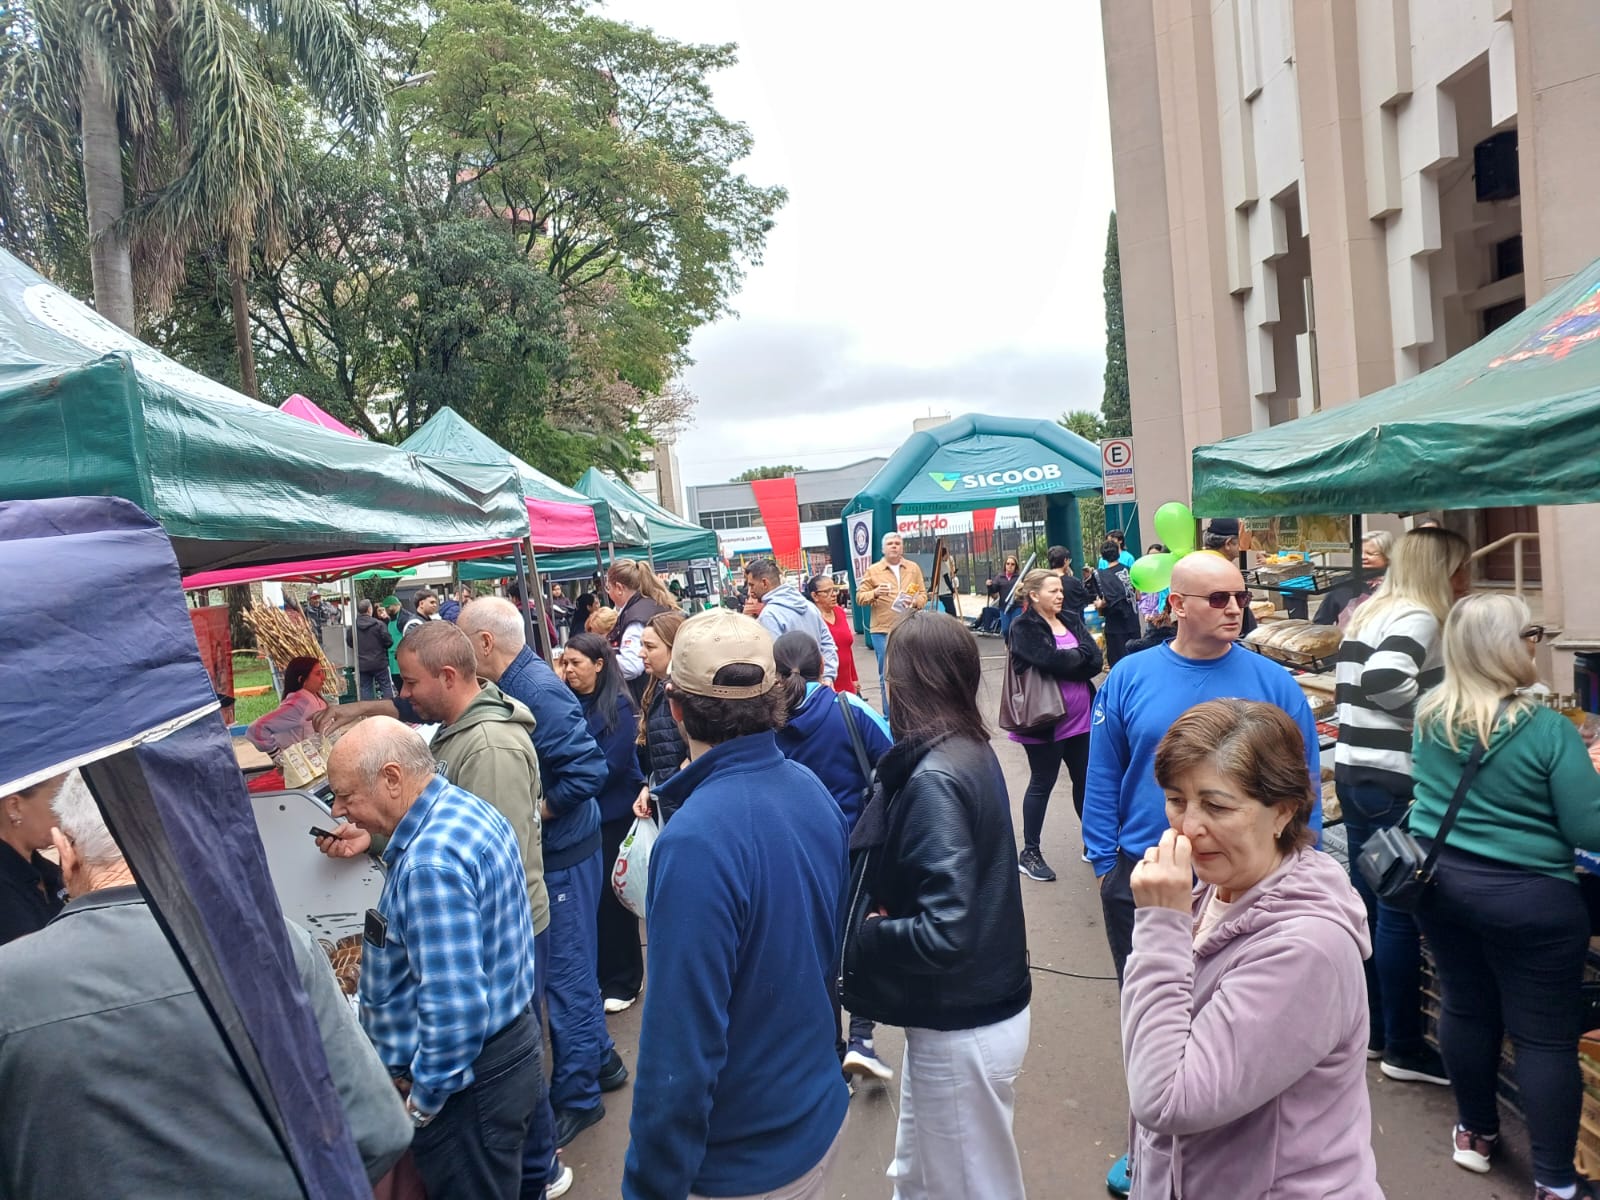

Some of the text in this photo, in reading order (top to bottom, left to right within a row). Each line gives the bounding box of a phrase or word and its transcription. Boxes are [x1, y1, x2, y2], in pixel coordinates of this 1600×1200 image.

[1111, 446, 1122, 463] E
[962, 464, 1062, 489] SICOOB
[898, 514, 948, 533] ercado
